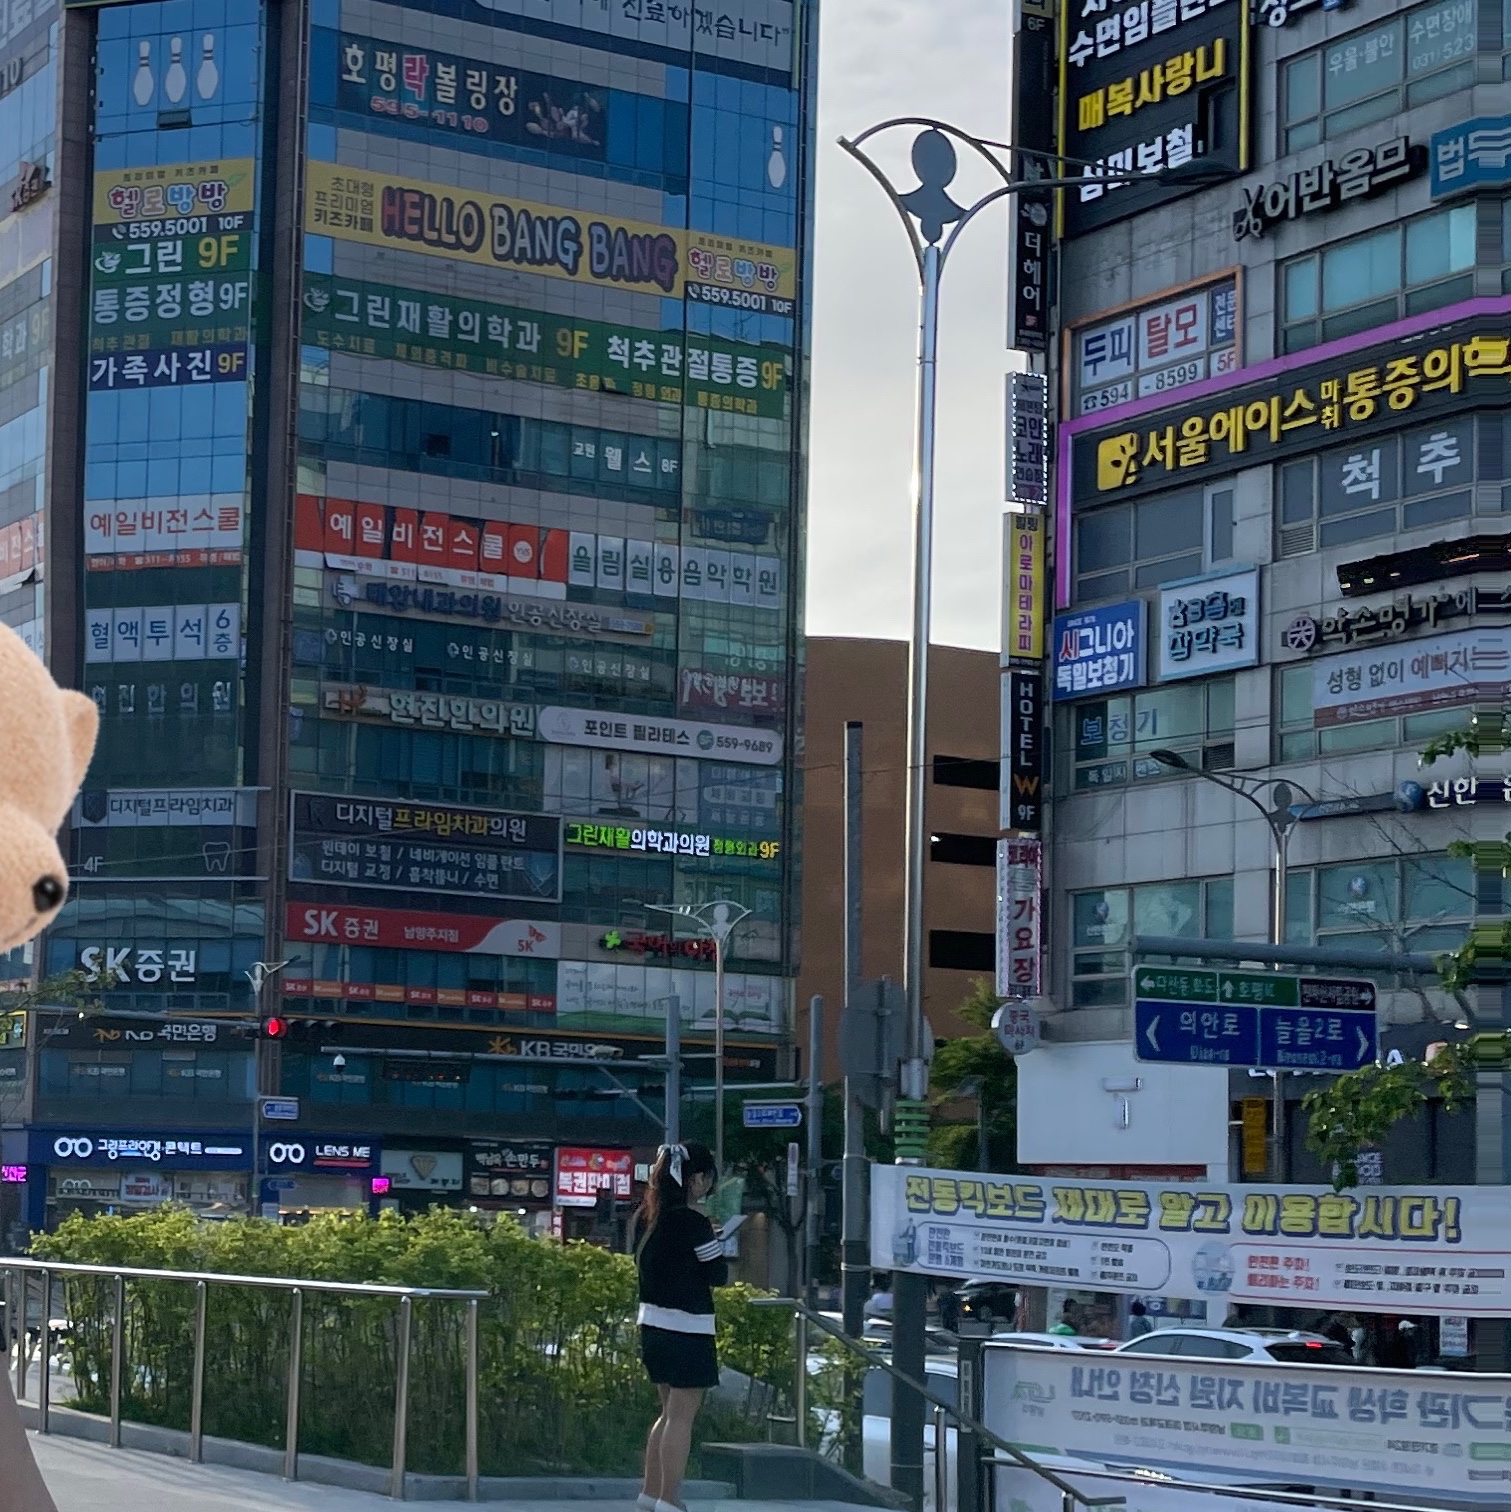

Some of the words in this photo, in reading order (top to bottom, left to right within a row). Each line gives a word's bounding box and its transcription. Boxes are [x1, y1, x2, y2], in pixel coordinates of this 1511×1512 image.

[341, 42, 519, 116] 호평락볼링장
[1078, 38, 1227, 132] 매복사랑니
[331, 176, 375, 198] 초대형
[1262, 136, 1411, 220] 어반옴므
[108, 180, 228, 218] 헬로방방
[314, 190, 375, 216] 프리미엄
[129, 217, 207, 238] 559.5001
[218, 215, 244, 231] 10F
[314, 207, 375, 233] 키즈카페
[381, 186, 485, 252] HELLO
[490, 203, 584, 277] BANG
[588, 222, 678, 292] BANG
[125, 240, 183, 275] 그린
[198, 234, 240, 269] 9F
[689, 248, 781, 292] 헬로방방
[94, 280, 215, 324] 통증정형
[218, 282, 249, 311] 9F
[701, 286, 768, 312] 559.5001
[772, 299, 793, 314] 10F
[335, 289, 541, 354] 그린재활의학과
[555, 328, 589, 359] 9F
[761, 361, 783, 391] 9F
[1084, 323, 1133, 377] 두피
[1145, 303, 1198, 360] 탈모
[91, 350, 213, 388] 가족사진
[217, 352, 246, 374] 9F
[1141, 386, 1319, 471] 서울에이스
[1341, 431, 1462, 500] 척추
[90, 506, 241, 538] 예일비전스쿨
[329, 512, 504, 561] 예일비전스쿨
[90, 618, 202, 650] 혈액투석
[1321, 593, 1439, 646] 약손명가
[340, 630, 414, 654] 인공신장실
[1058, 618, 1136, 663] 시그니아
[1056, 652, 1135, 693] 독일보청기
[1326, 665, 1363, 695] 성형
[1368, 657, 1405, 690] 없이
[583, 718, 629, 740] 포인트
[633, 723, 691, 746] 필라테스
[716, 735, 774, 754] 559-9689
[1019, 682, 1034, 767] HOTEL
[1079, 708, 1160, 747] 보청기
[1013, 773, 1040, 797] W
[110, 797, 234, 818] 디지털프라임치과
[336, 802, 527, 843] 디지털프라임치과의원
[1017, 804, 1036, 822] 9F
[322, 839, 361, 857] 원데이
[566, 822, 711, 858] 그린재활의학과의원
[83, 856, 104, 873] 4F
[321, 859, 359, 878] 디지털
[474, 871, 500, 890] 수면
[1012, 896, 1037, 983] 가요장
[1179, 1009, 1242, 1040] 의안로
[315, 1145, 350, 1158] LENS
[352, 1146, 371, 1158] ME
[906, 1175, 1046, 1224] 전동킥보드
[1051, 1186, 1152, 1231] 제대로
[1158, 1191, 1233, 1234] 알고
[1241, 1192, 1463, 1244] 이용합시다!
